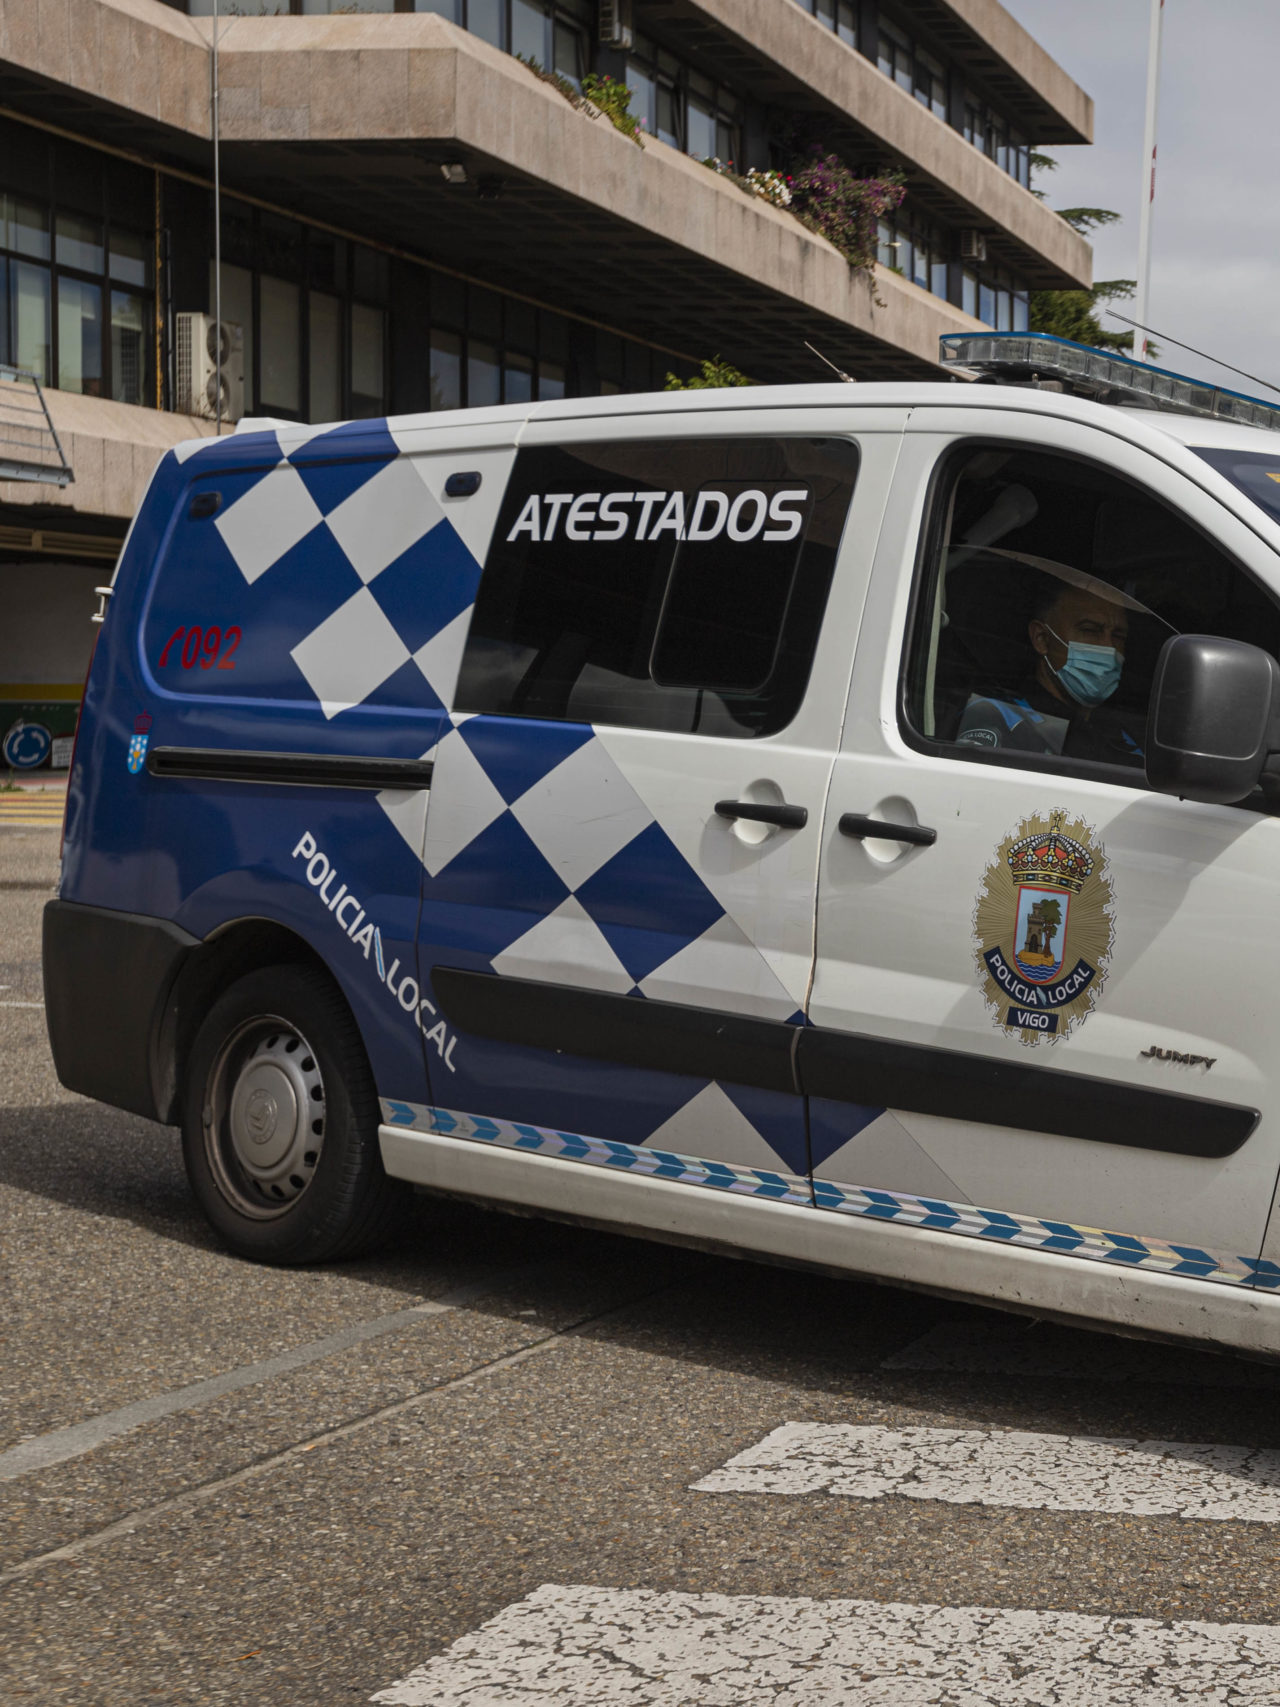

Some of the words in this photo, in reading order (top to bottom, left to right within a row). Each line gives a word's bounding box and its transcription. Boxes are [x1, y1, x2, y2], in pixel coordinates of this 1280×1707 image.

[507, 489, 808, 542] ATESTADOS
[181, 625, 242, 670] 092
[291, 831, 375, 960] POLICIA
[386, 958, 457, 1072] LOCAL
[989, 952, 1038, 1005] POLICIA
[1048, 963, 1090, 1004] LOCAL
[1017, 1010, 1049, 1029] VIGO
[1140, 1045, 1218, 1069] JUMPY
